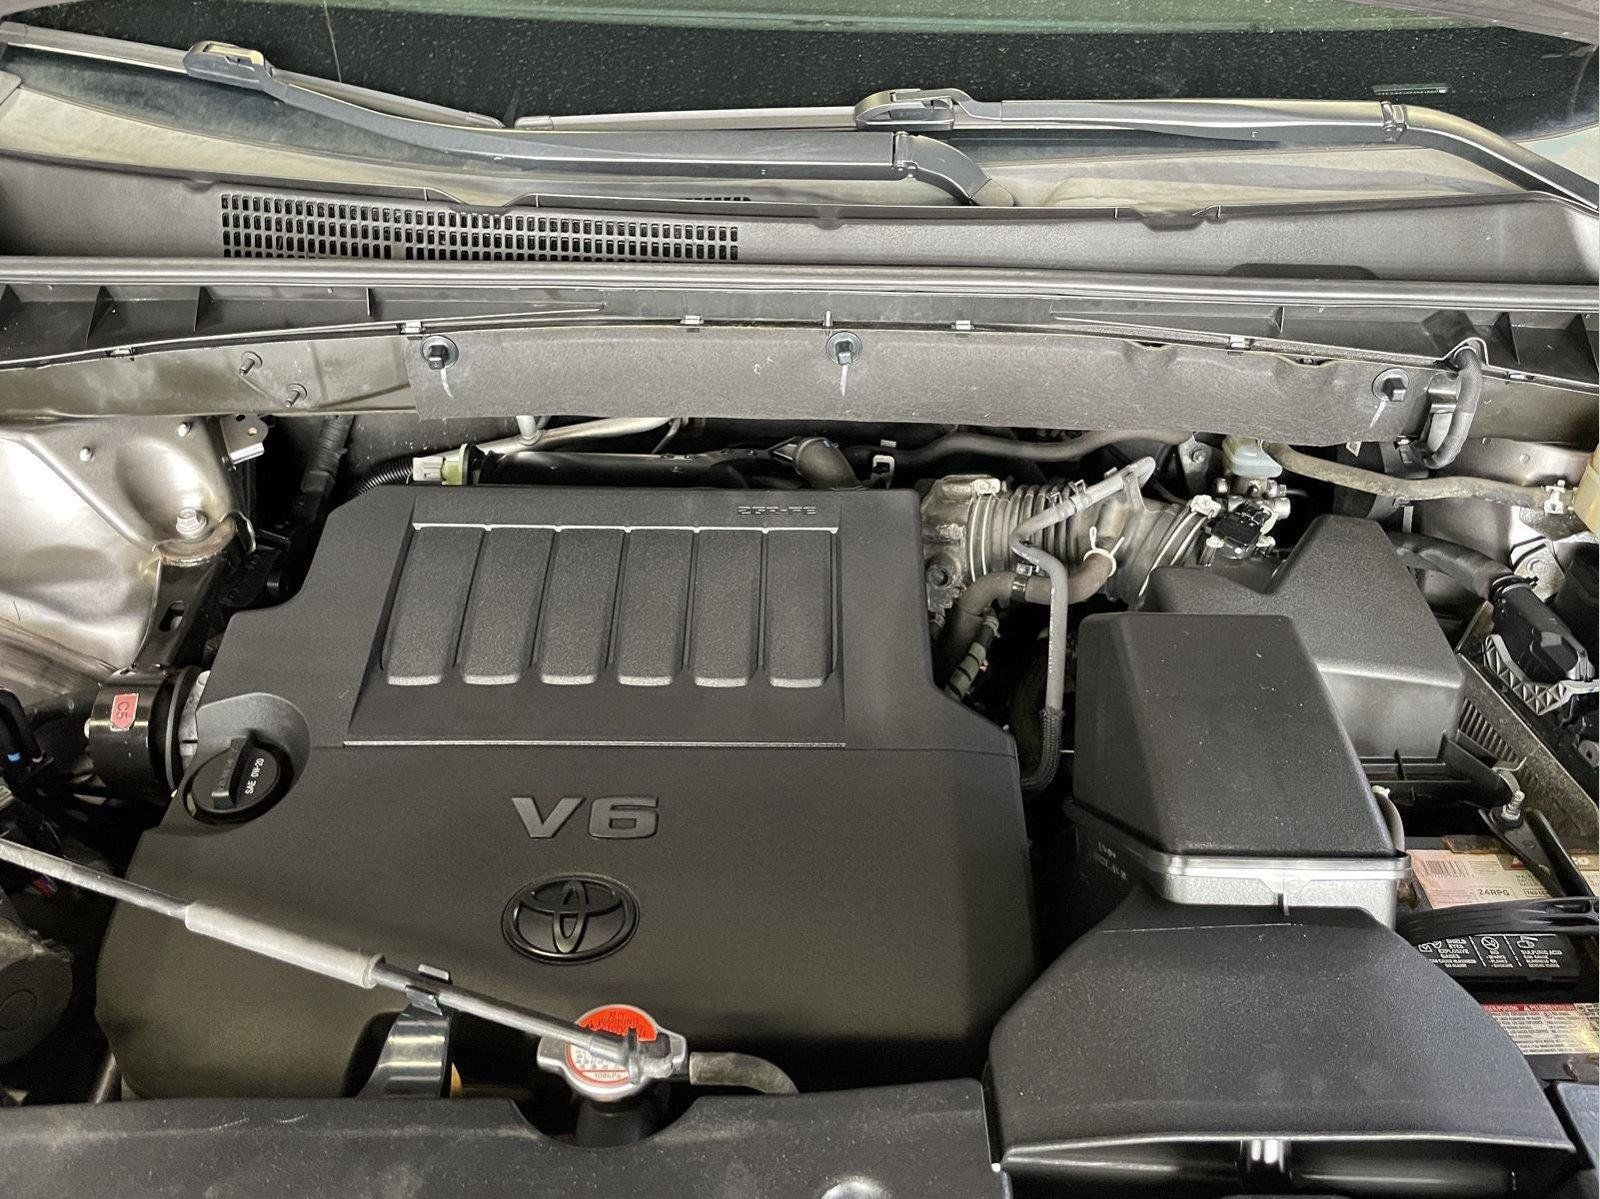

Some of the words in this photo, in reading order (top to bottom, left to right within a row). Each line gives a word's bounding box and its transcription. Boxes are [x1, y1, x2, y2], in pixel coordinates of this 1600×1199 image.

[245, 778, 257, 795] SAE
[511, 796, 659, 840] V6
[1477, 887, 1511, 897] 24RPG
